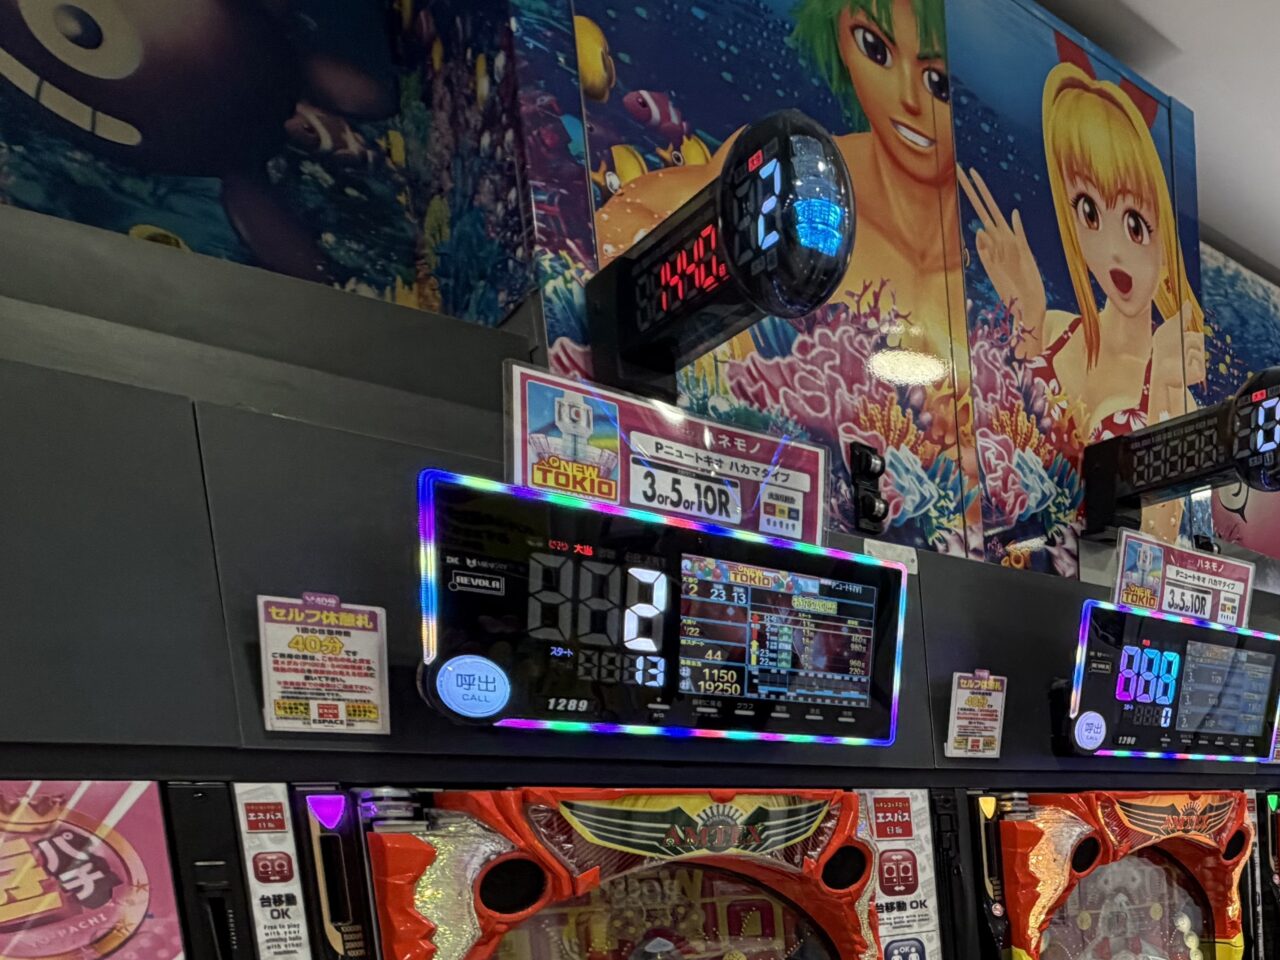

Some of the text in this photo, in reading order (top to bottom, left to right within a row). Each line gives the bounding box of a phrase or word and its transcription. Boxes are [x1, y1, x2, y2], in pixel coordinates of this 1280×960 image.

[758, 158, 782, 250] 2
[533, 464, 616, 498] TOKIO
[710, 588, 726, 601] 23
[732, 592, 746, 604] 13
[624, 567, 667, 651] 2
[268, 606, 374, 628] セルフ休憩札
[456, 673, 497, 692] 呼出
[702, 668, 737, 683] 1150
[698, 681, 741, 696] 19250
[462, 693, 490, 703] CALL
[548, 698, 588, 712] 1289
[876, 811, 910, 823] エスパス
[910, 899, 928, 909] OK
[270, 908, 291, 919] OK
